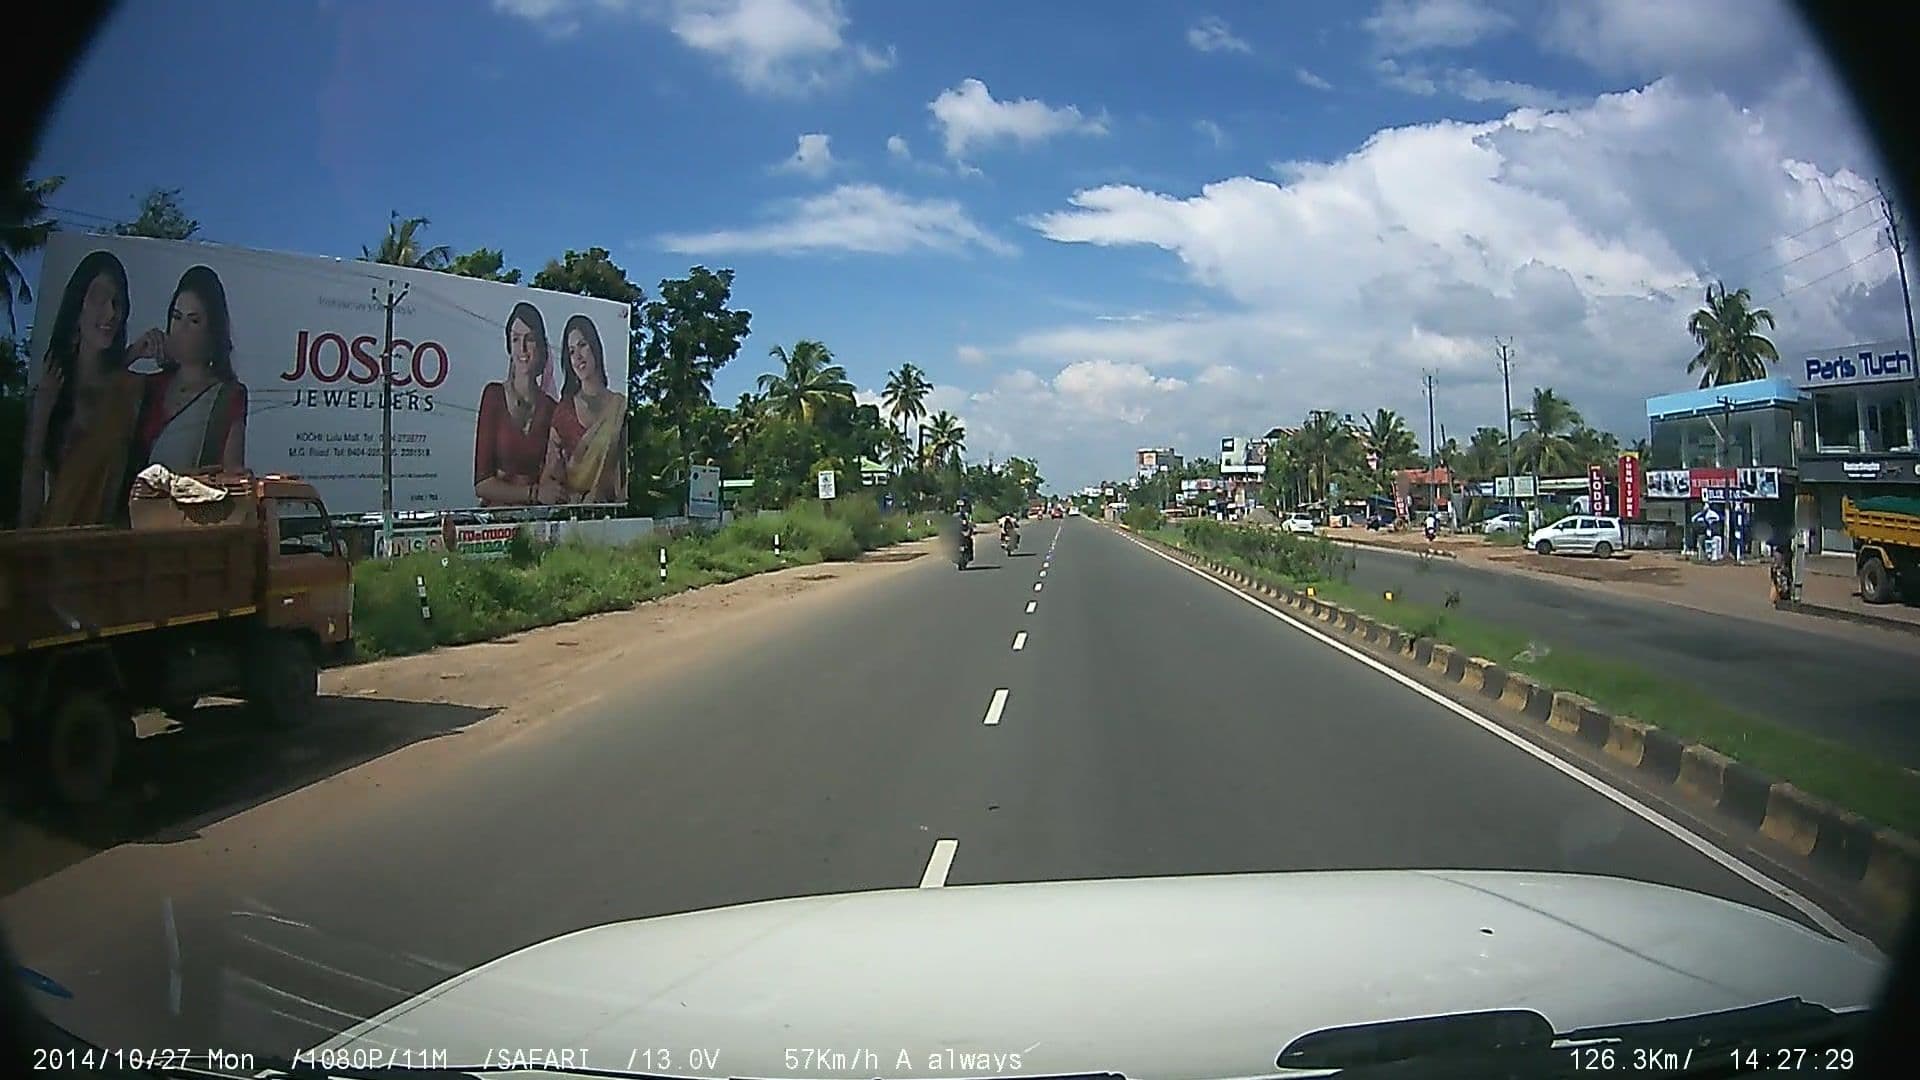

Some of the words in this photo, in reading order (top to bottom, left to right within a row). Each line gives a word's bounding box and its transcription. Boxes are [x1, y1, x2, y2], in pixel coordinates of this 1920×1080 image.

[280, 330, 449, 389] JOSCO
[1805, 356, 1856, 381] Paris
[1858, 350, 1912, 376] Tuch
[292, 389, 434, 412] JEWELLERS
[1625, 456, 1633, 517] FURNITURE
